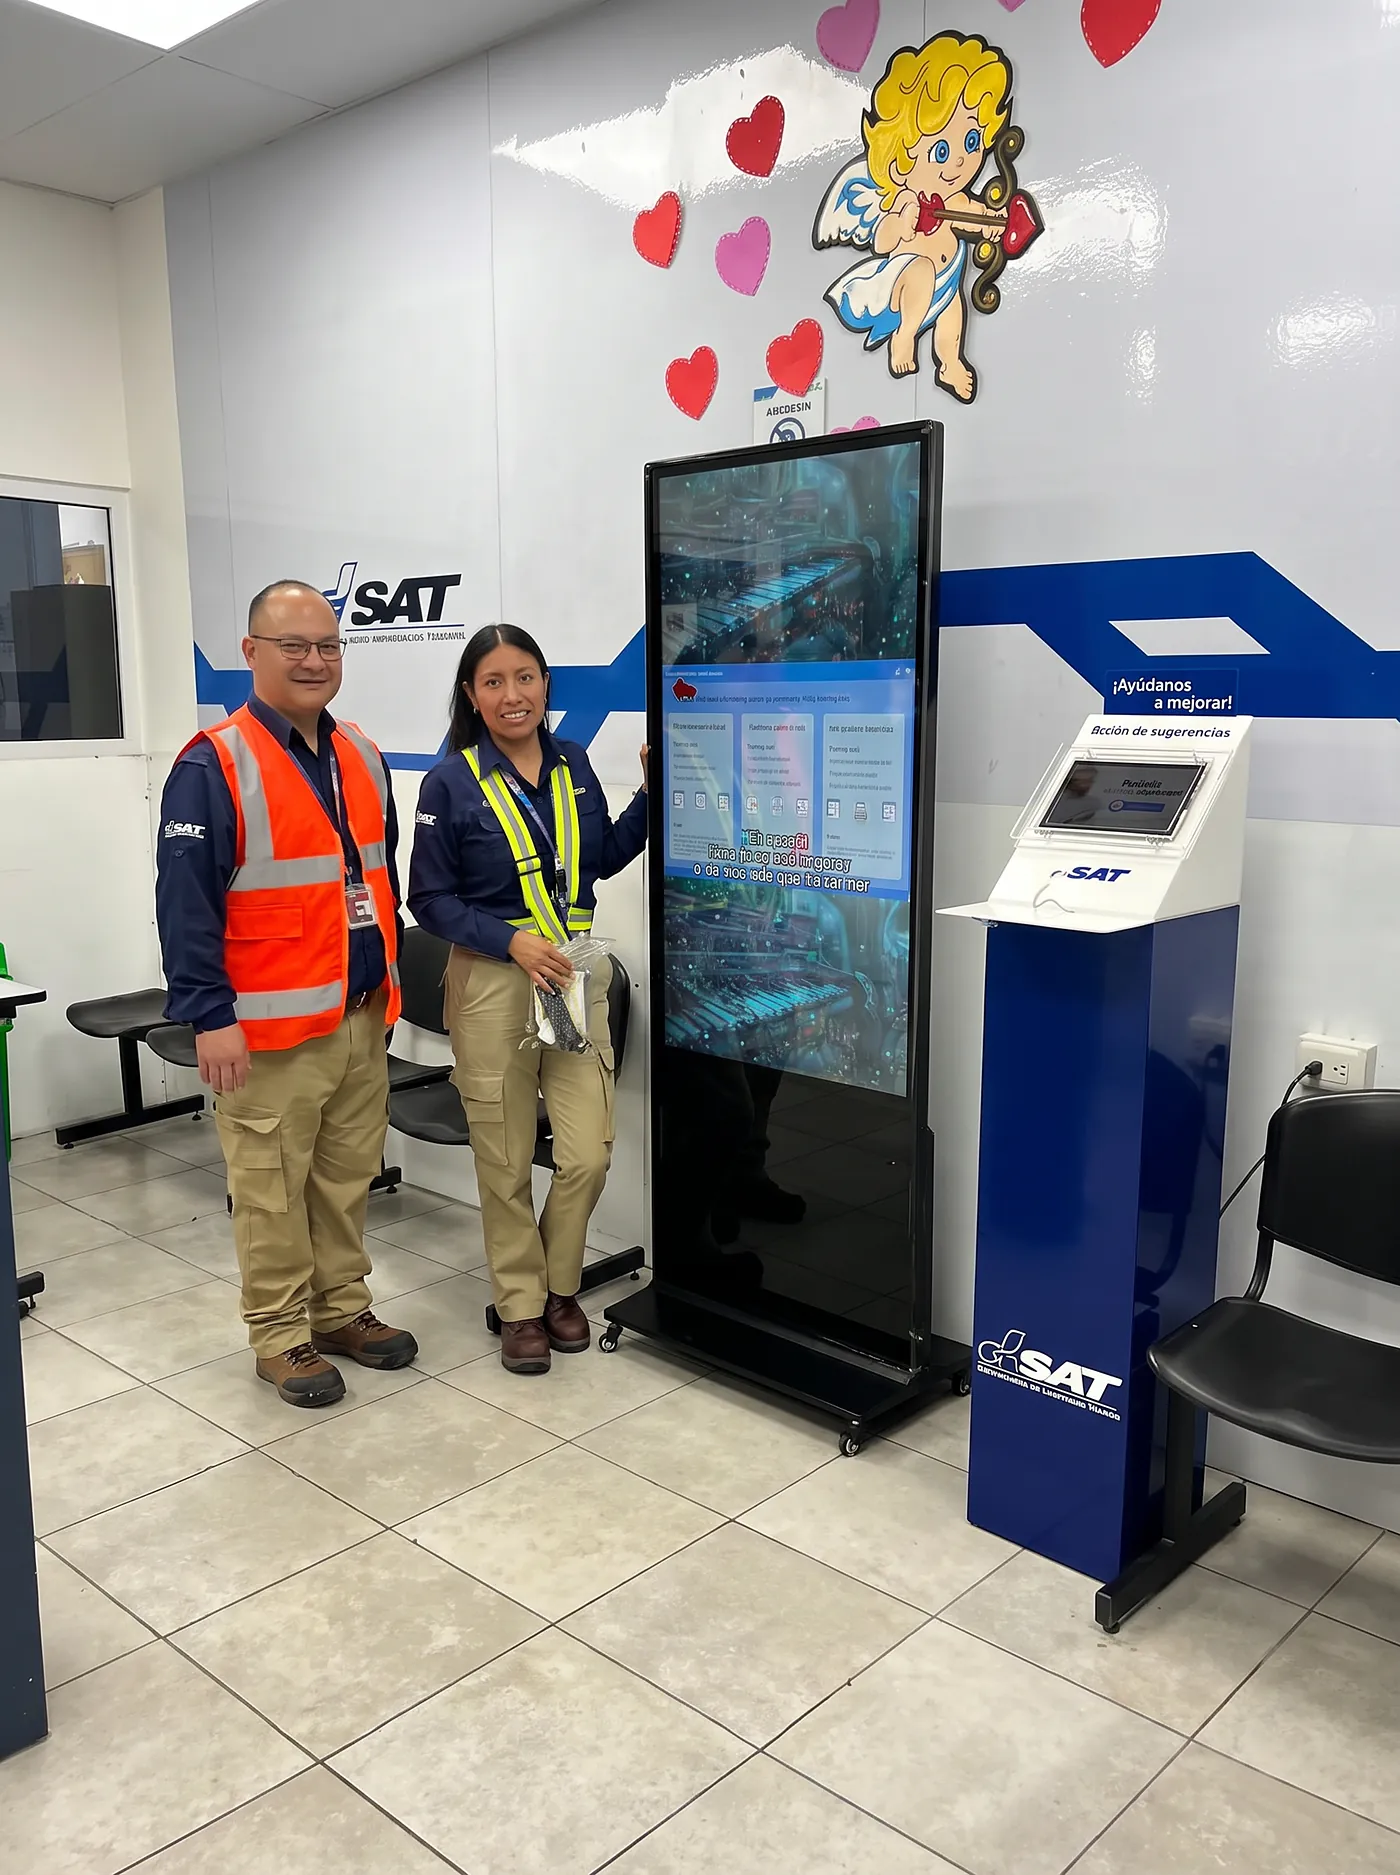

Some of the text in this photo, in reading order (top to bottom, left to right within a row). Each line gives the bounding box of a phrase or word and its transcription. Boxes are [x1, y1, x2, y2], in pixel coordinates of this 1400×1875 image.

[351, 574, 462, 626] SAT
[1113, 677, 1192, 696] ¡Ayúdanos
[1154, 695, 1233, 713] a mejorar!
[1132, 726, 1148, 736] de
[1150, 727, 1231, 739] sugerencias
[1067, 866, 1132, 882] SAT
[1019, 1350, 1123, 1402] SAT
